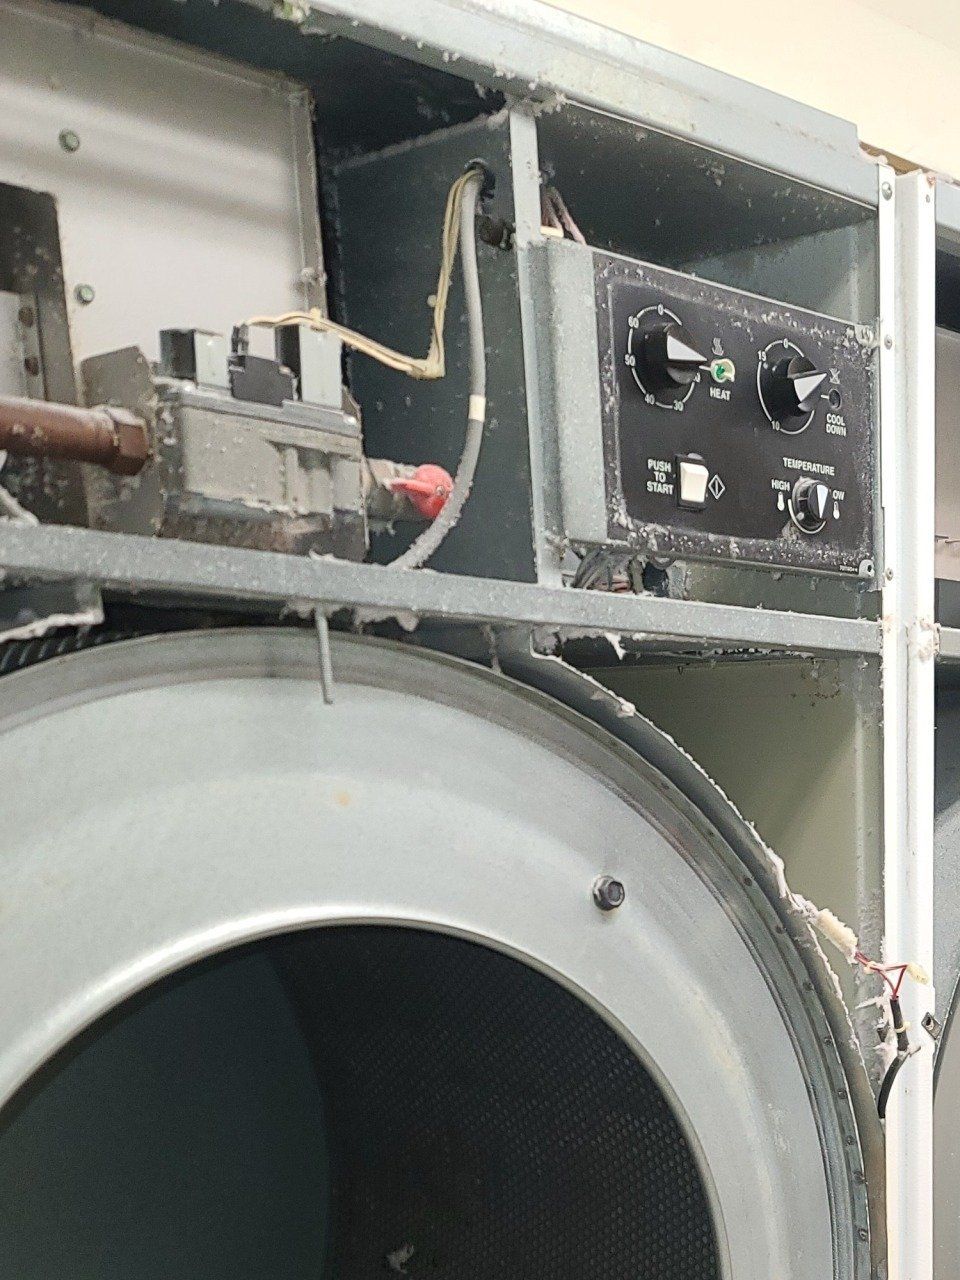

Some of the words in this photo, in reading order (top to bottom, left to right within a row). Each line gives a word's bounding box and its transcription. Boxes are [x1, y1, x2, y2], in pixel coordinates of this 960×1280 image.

[657, 303, 664, 316] 0
[628, 315, 639, 328] 60
[624, 353, 636, 367] 50
[757, 350, 767, 361] 15
[644, 393, 655, 405] 40
[709, 387, 731, 401] HEAT
[673, 399, 684, 412] 30
[771, 420, 780, 431] 10
[826, 413, 845, 426] COOL
[825, 423, 847, 437] DOWN
[647, 458, 672, 473] PUSH
[782, 457, 835, 476] TEMPERATURE
[653, 471, 667, 483] TO
[646, 480, 674, 495] START
[771, 479, 790, 492] HIGH
[829, 488, 845, 501] OW
